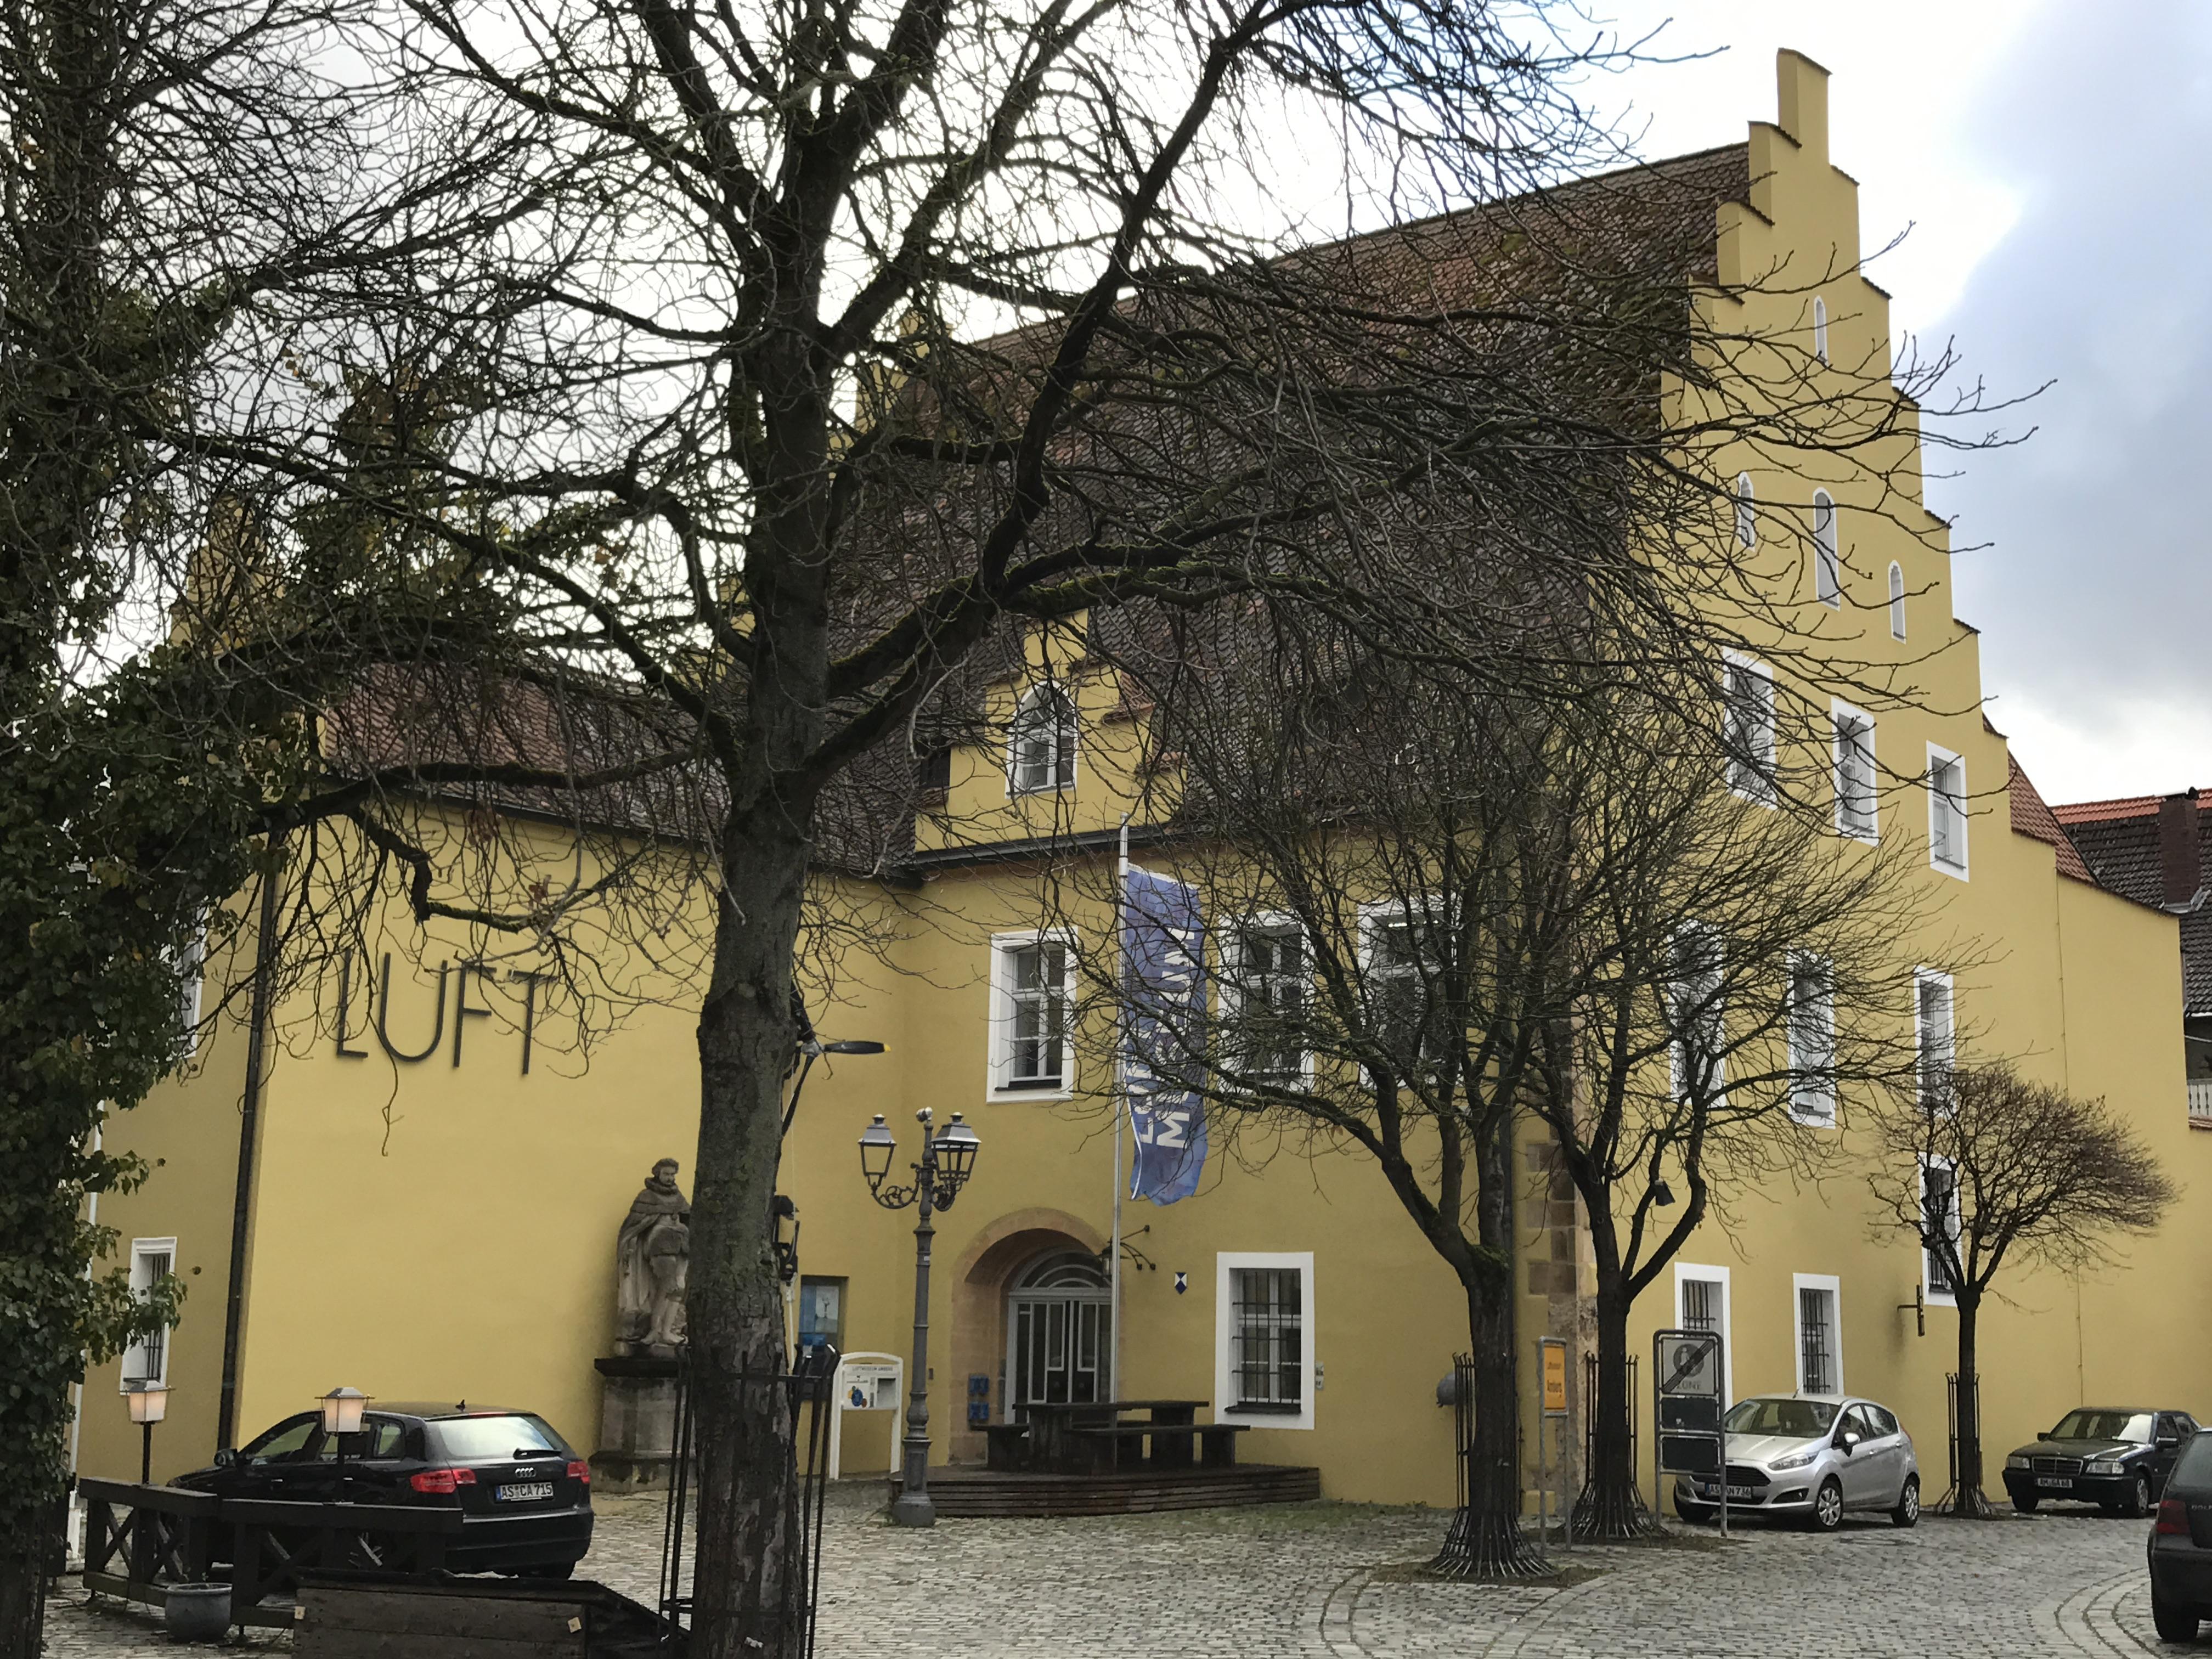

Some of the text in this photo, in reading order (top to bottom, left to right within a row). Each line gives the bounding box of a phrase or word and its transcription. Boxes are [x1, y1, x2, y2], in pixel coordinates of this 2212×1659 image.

[336, 948, 558, 1075] LUFT
[502, 1483, 552, 1498] AS CA 715
